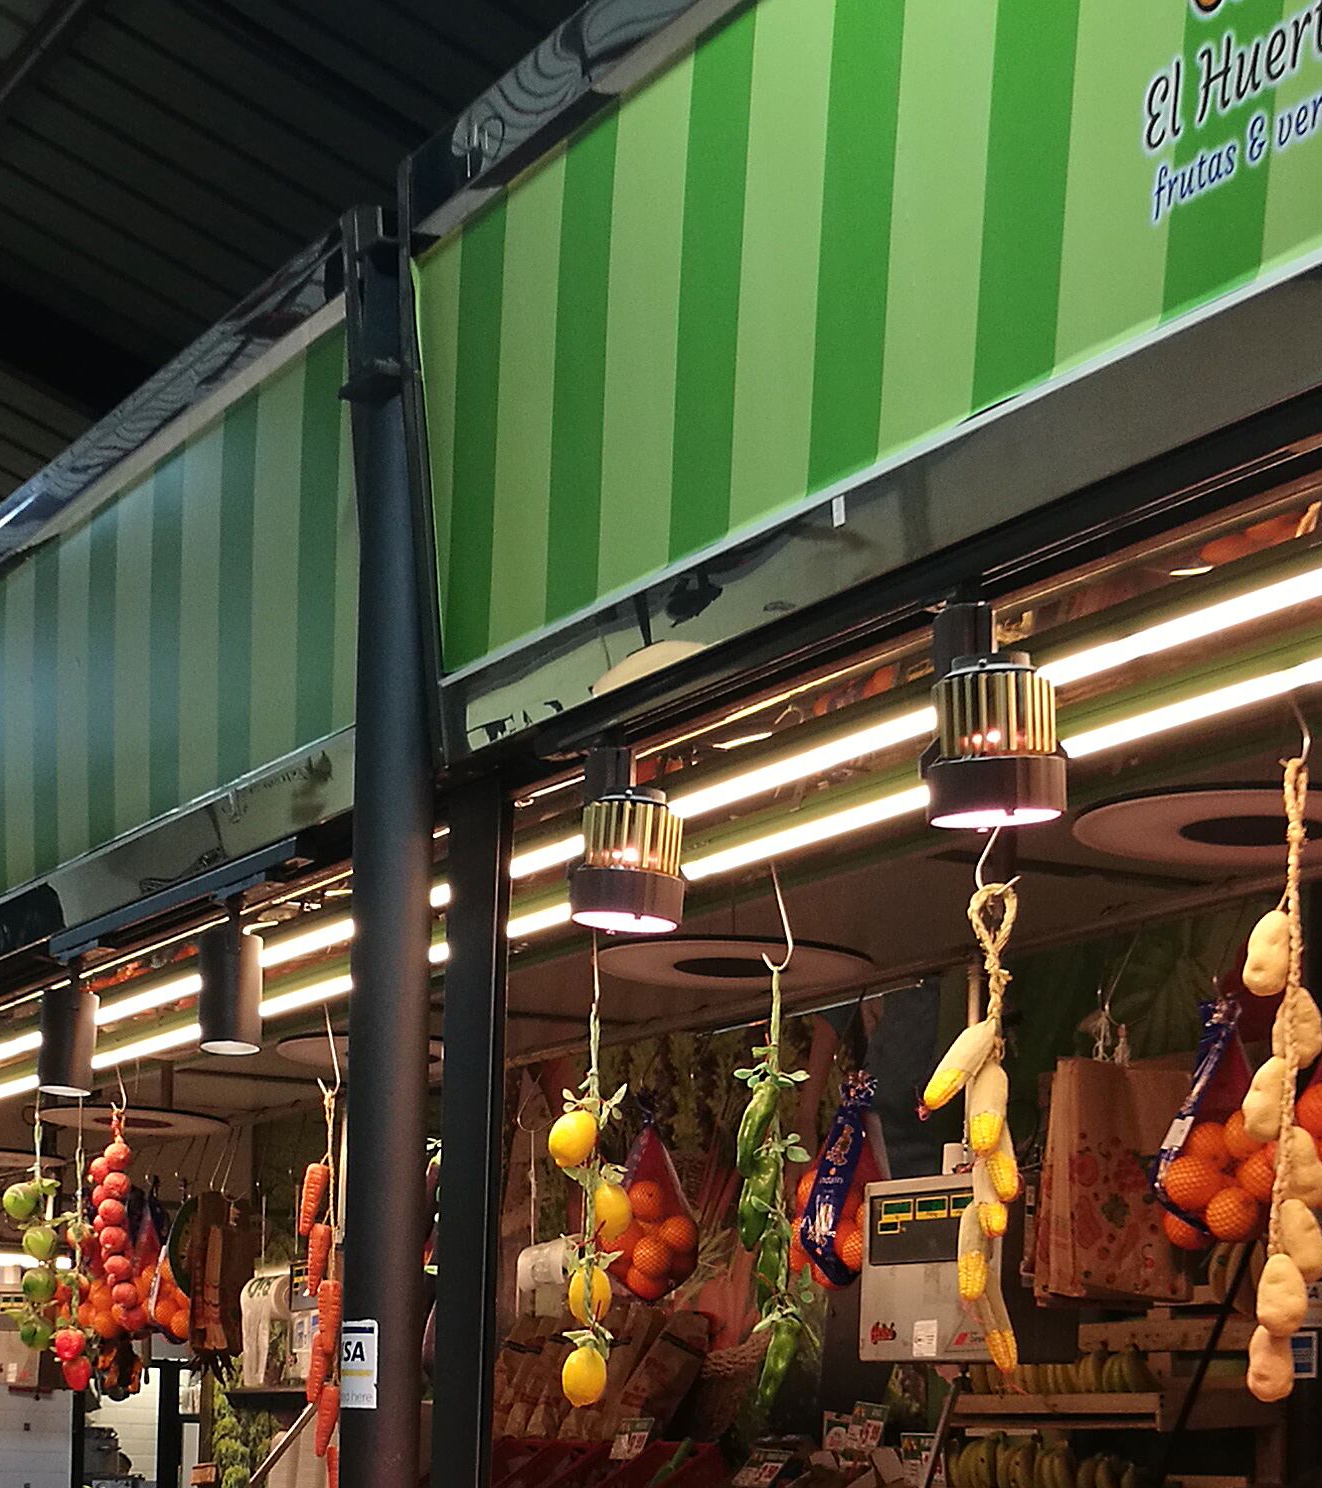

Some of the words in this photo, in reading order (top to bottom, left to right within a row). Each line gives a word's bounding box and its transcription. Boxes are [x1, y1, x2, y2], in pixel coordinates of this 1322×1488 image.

[1145, 61, 1181, 149] El
[1153, 144, 1236, 221] frutas
[1248, 116, 1268, 162] &
